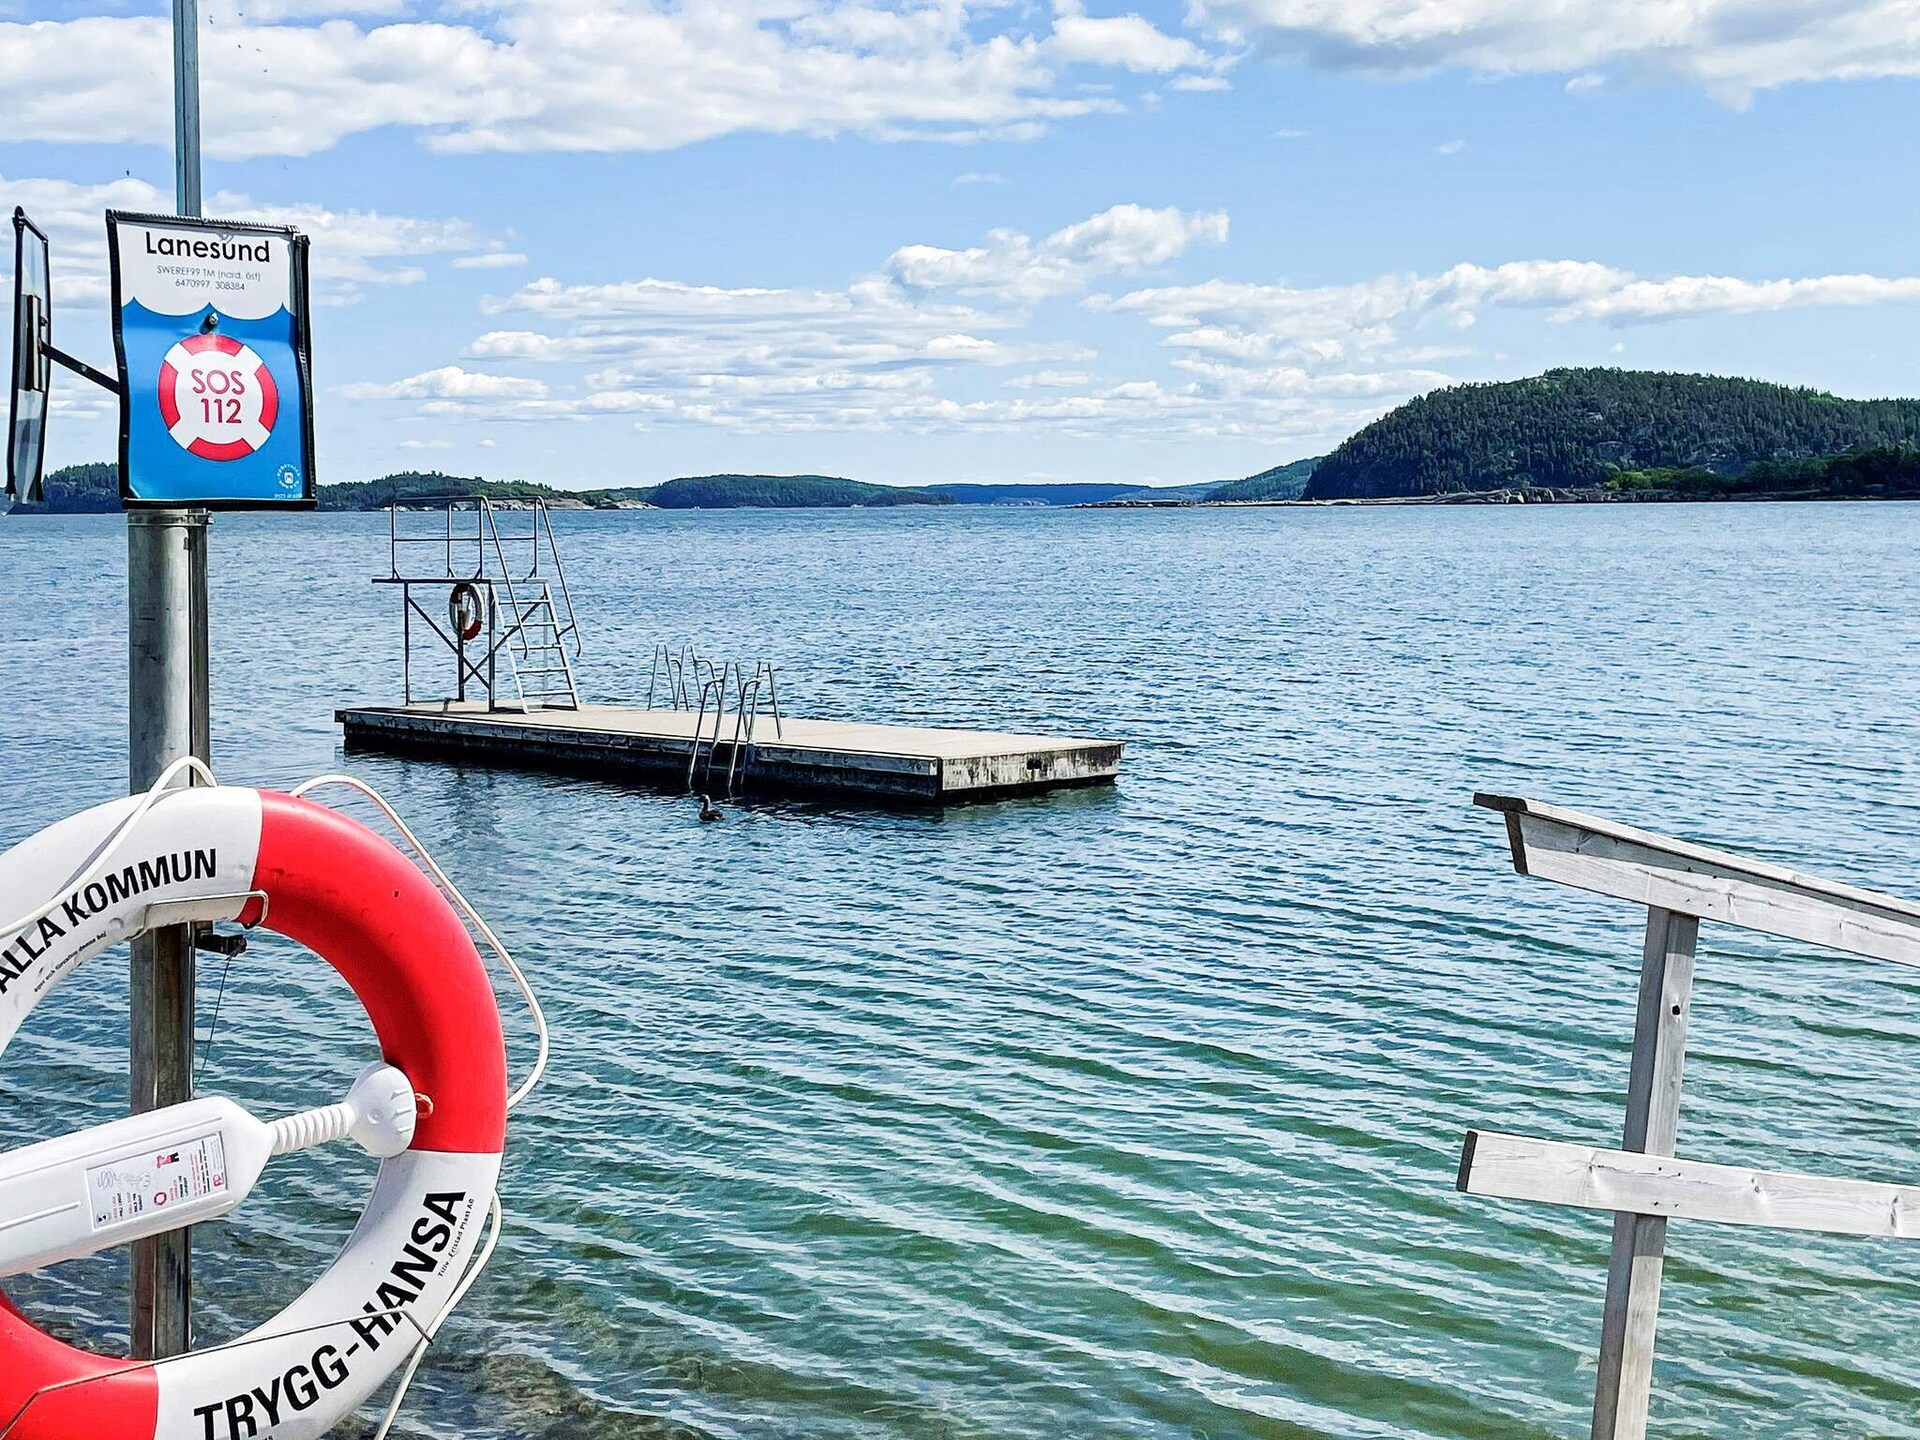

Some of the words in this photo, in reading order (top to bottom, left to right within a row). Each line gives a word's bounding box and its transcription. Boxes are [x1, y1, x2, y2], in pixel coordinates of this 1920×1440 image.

[145, 231, 270, 263] Lanesund
[157, 265, 200, 276] SWEREF99
[203, 268, 215, 278] TM
[191, 369, 245, 395] SOS
[200, 398, 242, 423] 112
[61, 848, 216, 928] KOMMUN
[193, 1191, 466, 1440] TRYGG-HANSA
